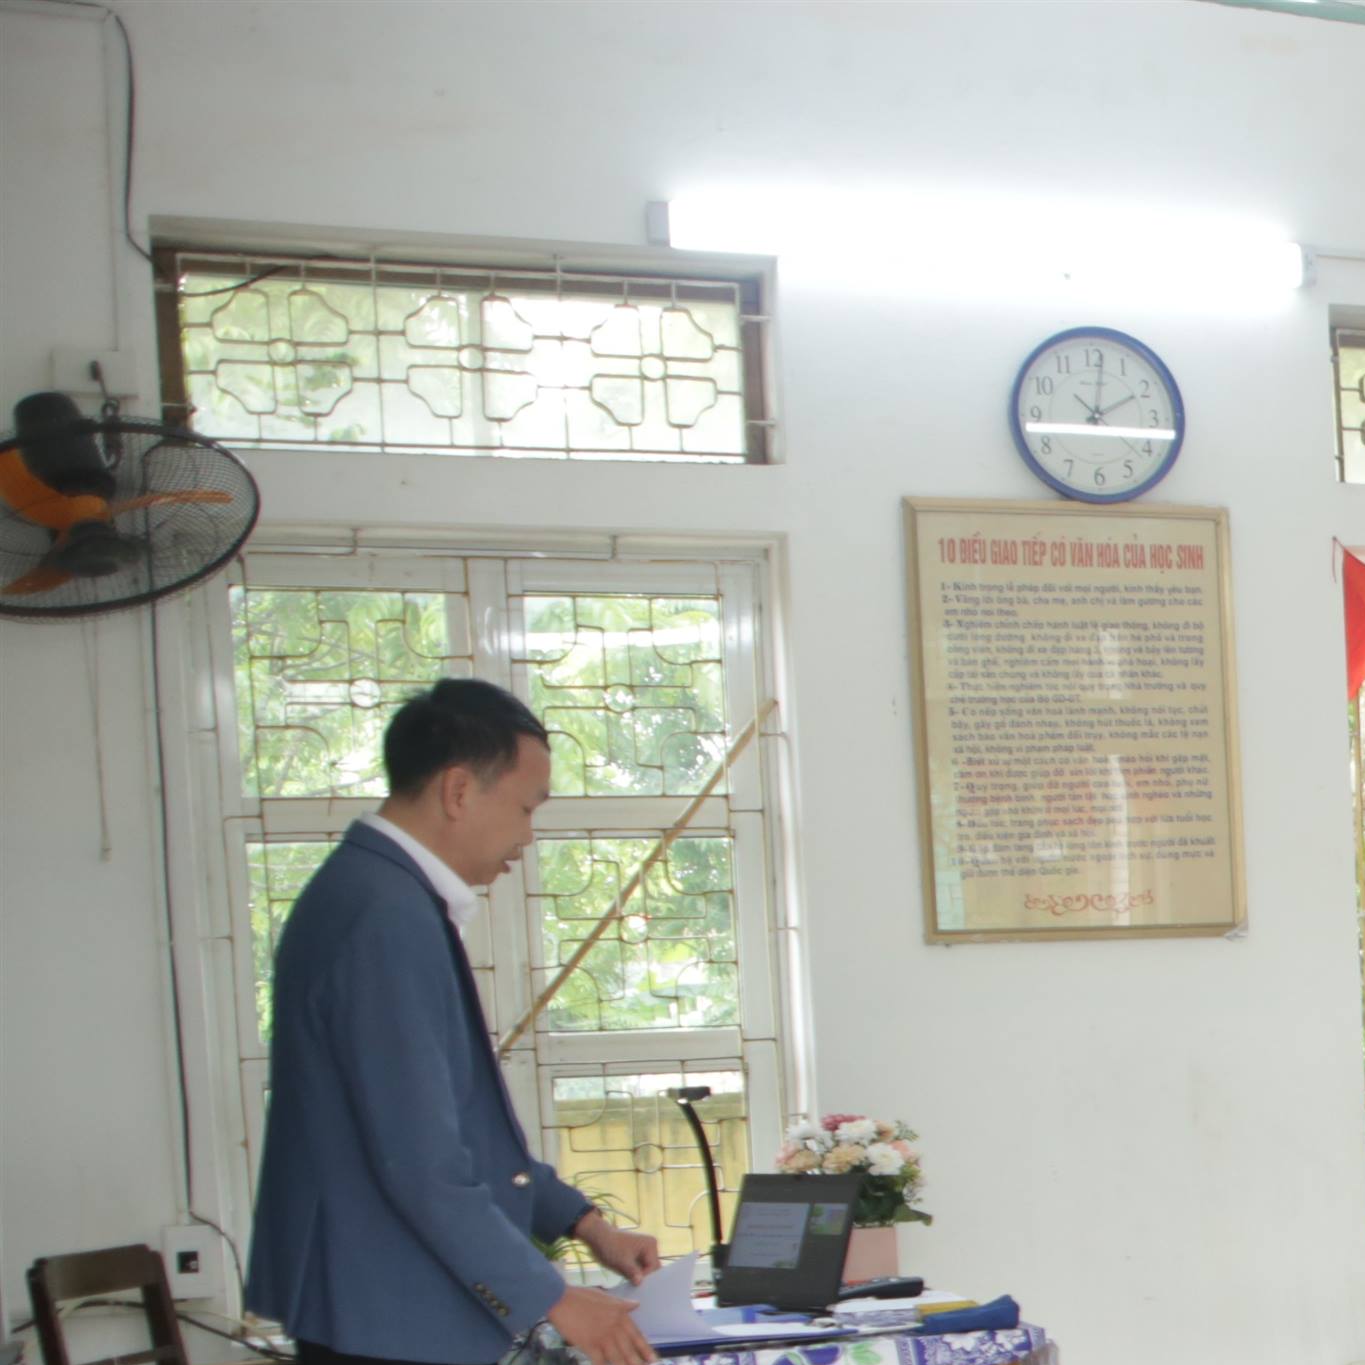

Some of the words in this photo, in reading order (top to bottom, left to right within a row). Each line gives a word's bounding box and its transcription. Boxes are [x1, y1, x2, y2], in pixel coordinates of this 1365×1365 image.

[1056, 355, 1071, 374] 11
[1083, 348, 1104, 368] 12
[1119, 358, 1127, 376] 1
[1034, 375, 1054, 395] 10
[1140, 379, 1151, 398] 2
[1030, 405, 1042, 424] 9
[1148, 410, 1160, 429] 3
[1040, 436, 1052, 456] 8
[1141, 438, 1153, 457] 4
[1063, 458, 1075, 478] 7
[1093, 466, 1106, 487] 6
[1122, 459, 1135, 479] 5
[991, 538, 1018, 566] GIAO
[1176, 543, 1205, 570] SINH
